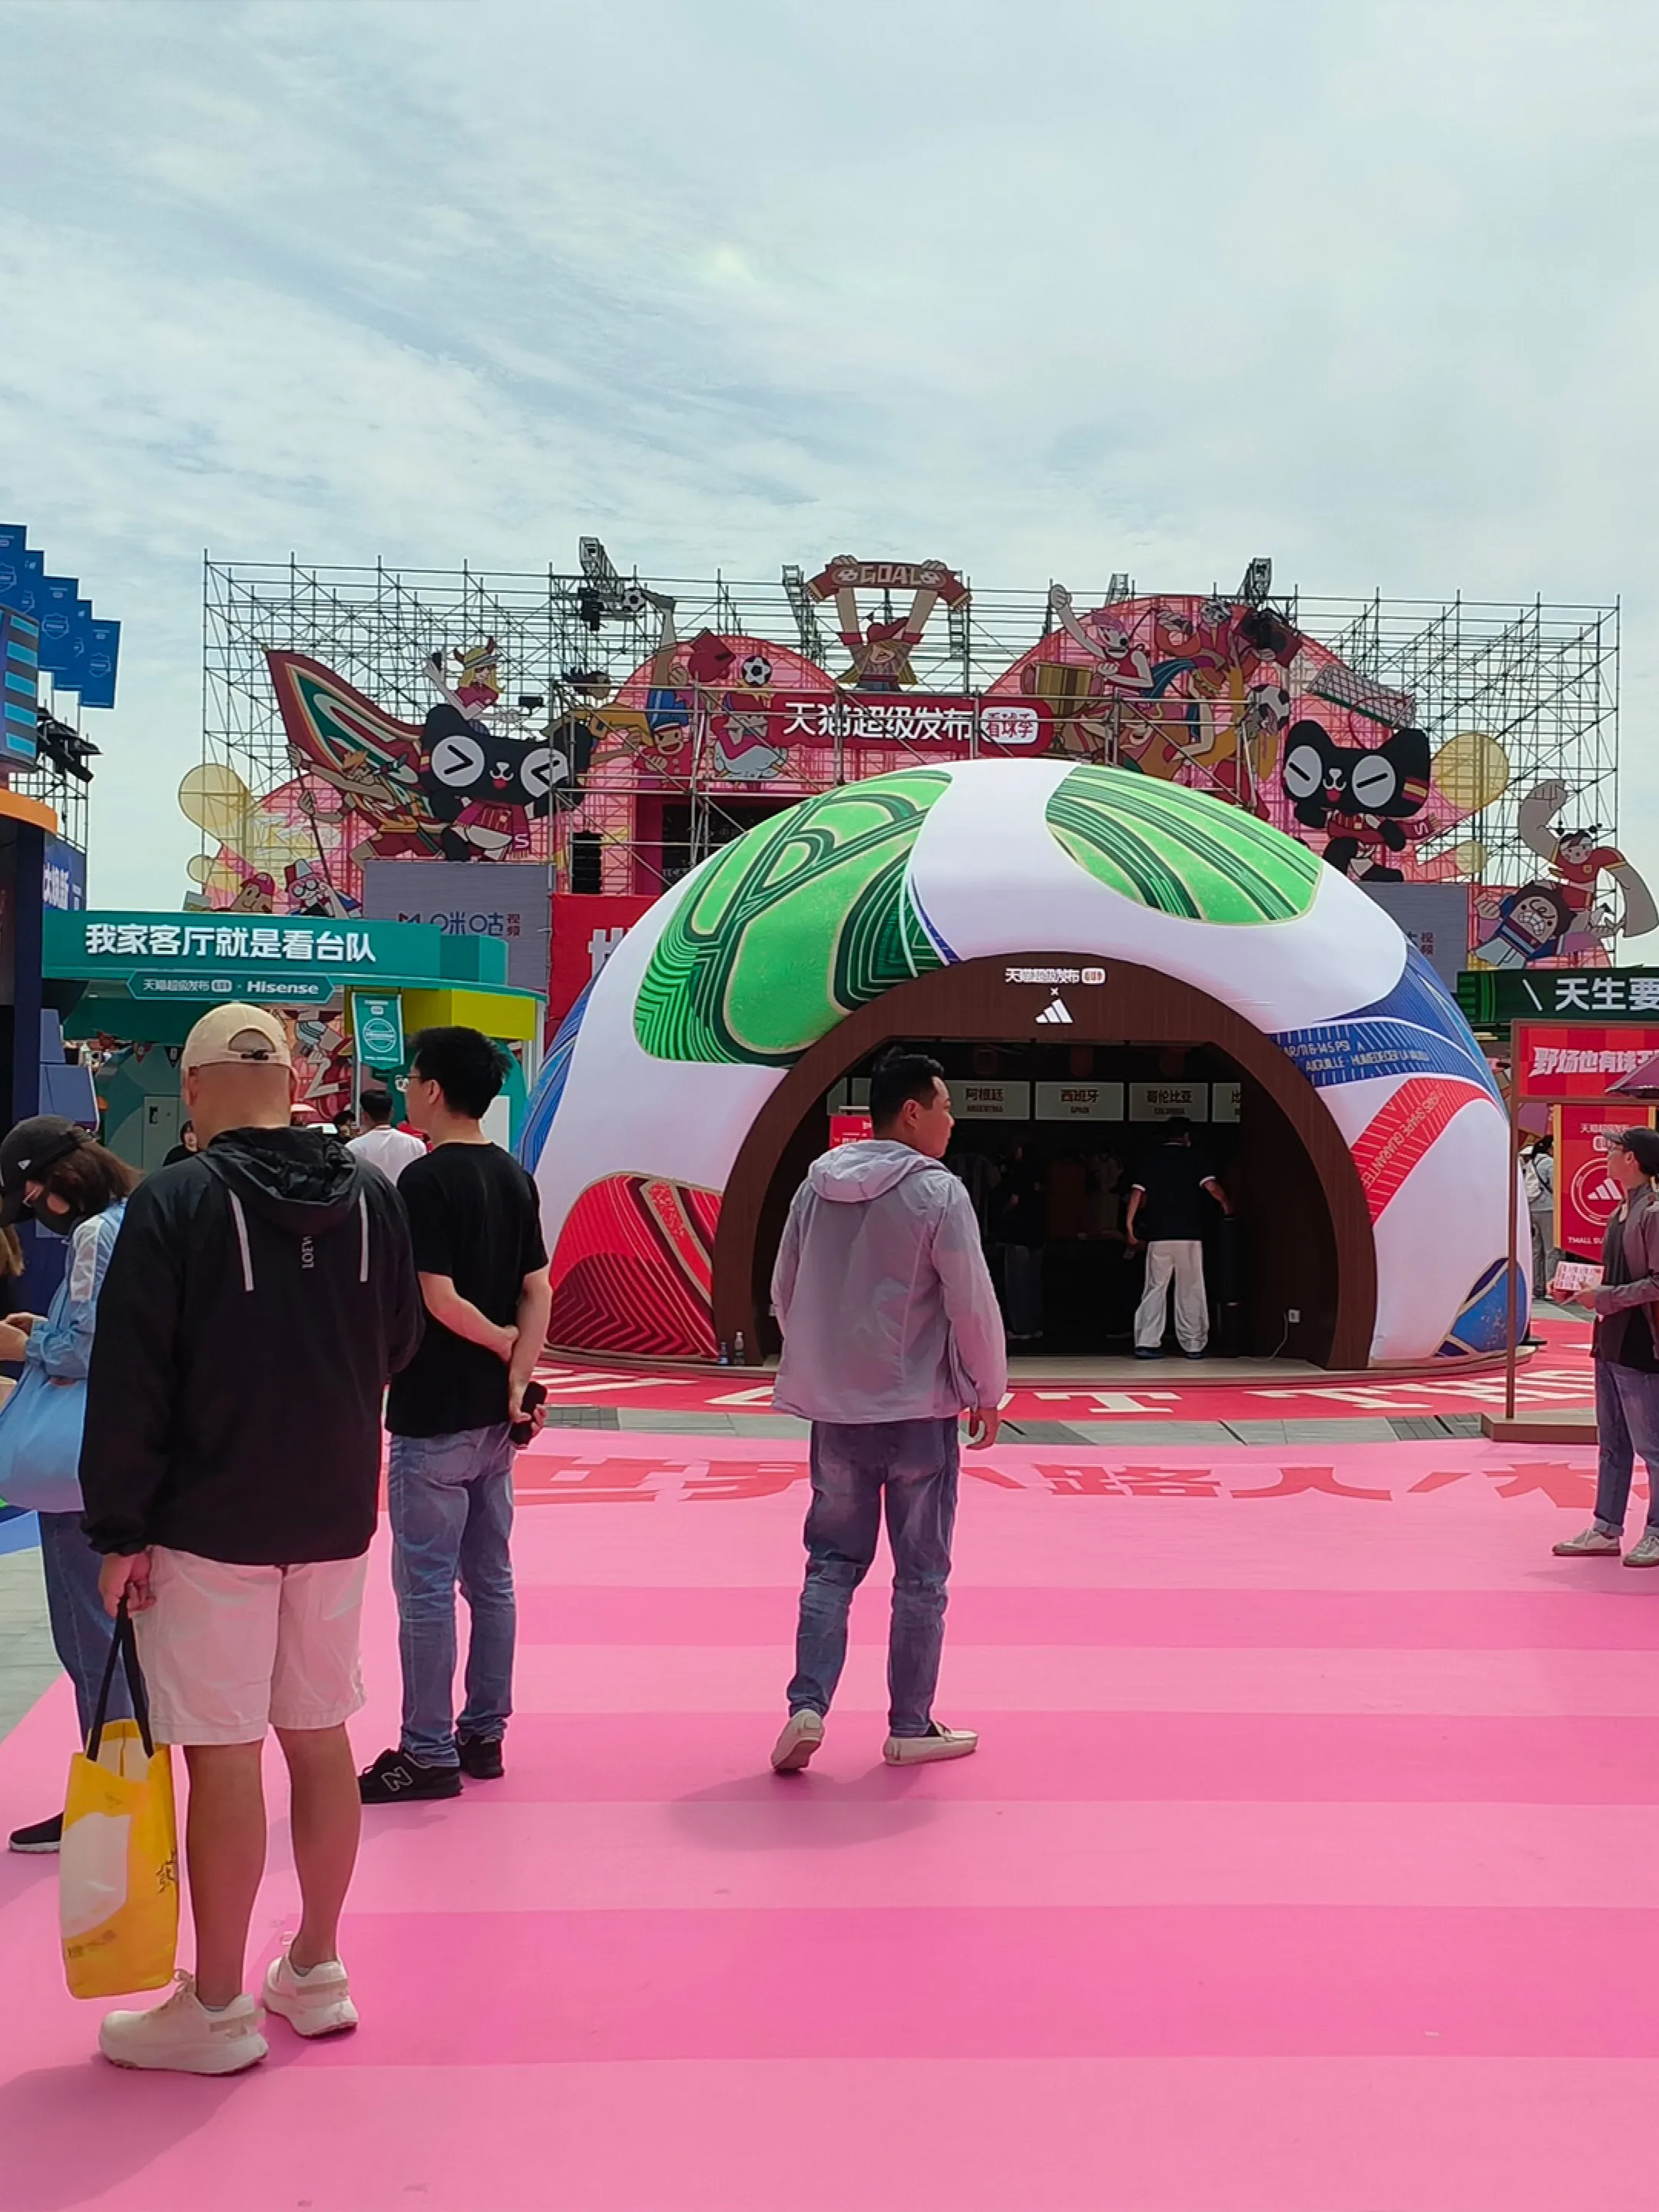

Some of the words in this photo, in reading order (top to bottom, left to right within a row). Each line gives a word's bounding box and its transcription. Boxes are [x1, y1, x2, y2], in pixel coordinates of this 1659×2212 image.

[860, 565, 922, 584] GOAL
[783, 702, 972, 740] 天猫超级发布
[85, 923, 376, 962] 我家客厅就是看台队
[247, 981, 320, 995] Hisense
[1555, 976, 1659, 1011] 天生要
[1061, 1089, 1099, 1102] 西班牙
[1147, 1090, 1192, 1104] 哥伦比亚
[301, 1234, 315, 1270] LOEW
